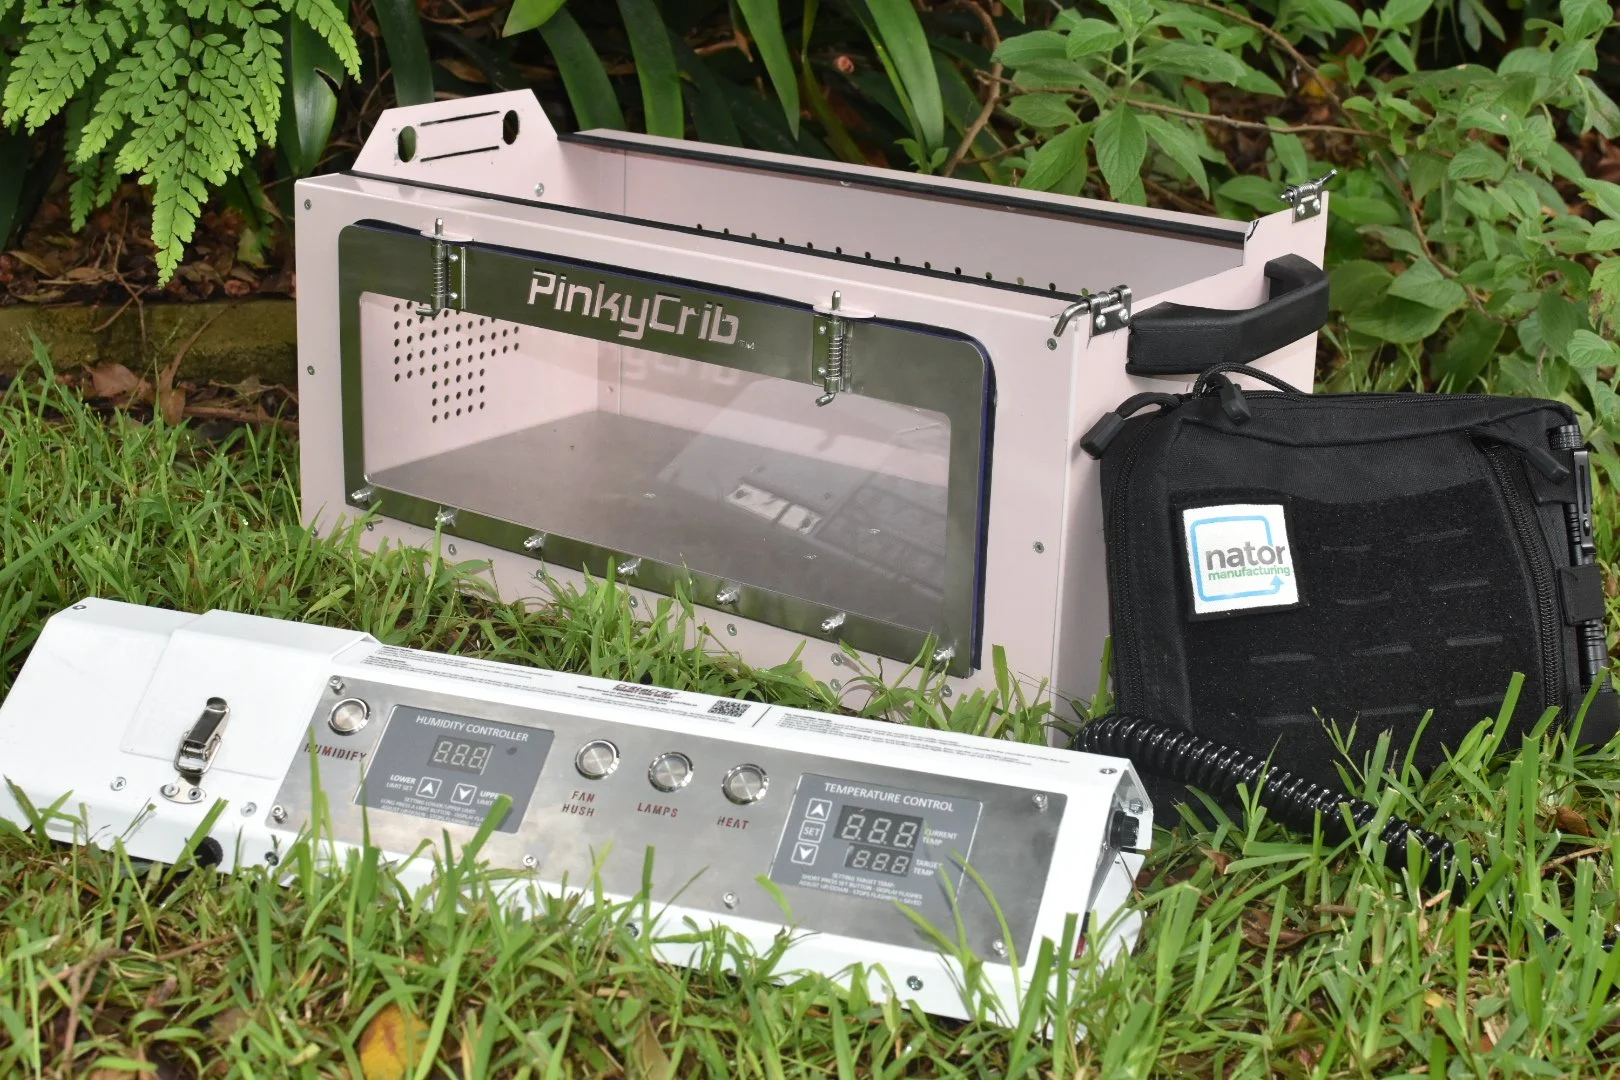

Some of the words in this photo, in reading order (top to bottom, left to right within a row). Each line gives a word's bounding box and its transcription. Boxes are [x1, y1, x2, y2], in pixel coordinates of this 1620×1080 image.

[527, 268, 739, 345] PinkyCrib
[1205, 541, 1286, 571] nator
[1208, 565, 1291, 581] manufacturing
[416, 715, 465, 731] HUMIDITY
[466, 724, 529, 742] CONTROLLER
[304, 743, 367, 761] HUMIDIFY
[390, 774, 417, 785] LOWER
[480, 790, 500, 801] UPPE
[571, 790, 596, 803] FAN
[824, 782, 901, 804] TEMPERATURE
[903, 796, 954, 812] CONTROL
[561, 803, 596, 817] HUSH
[637, 802, 679, 818] LAMPS
[717, 816, 749, 830] HEAT
[803, 826, 820, 837] SET
[924, 829, 957, 840] CURRENT
[922, 836, 943, 846] TEMP
[914, 867, 935, 876] TEMP
[916, 859, 943, 870] TARGET
